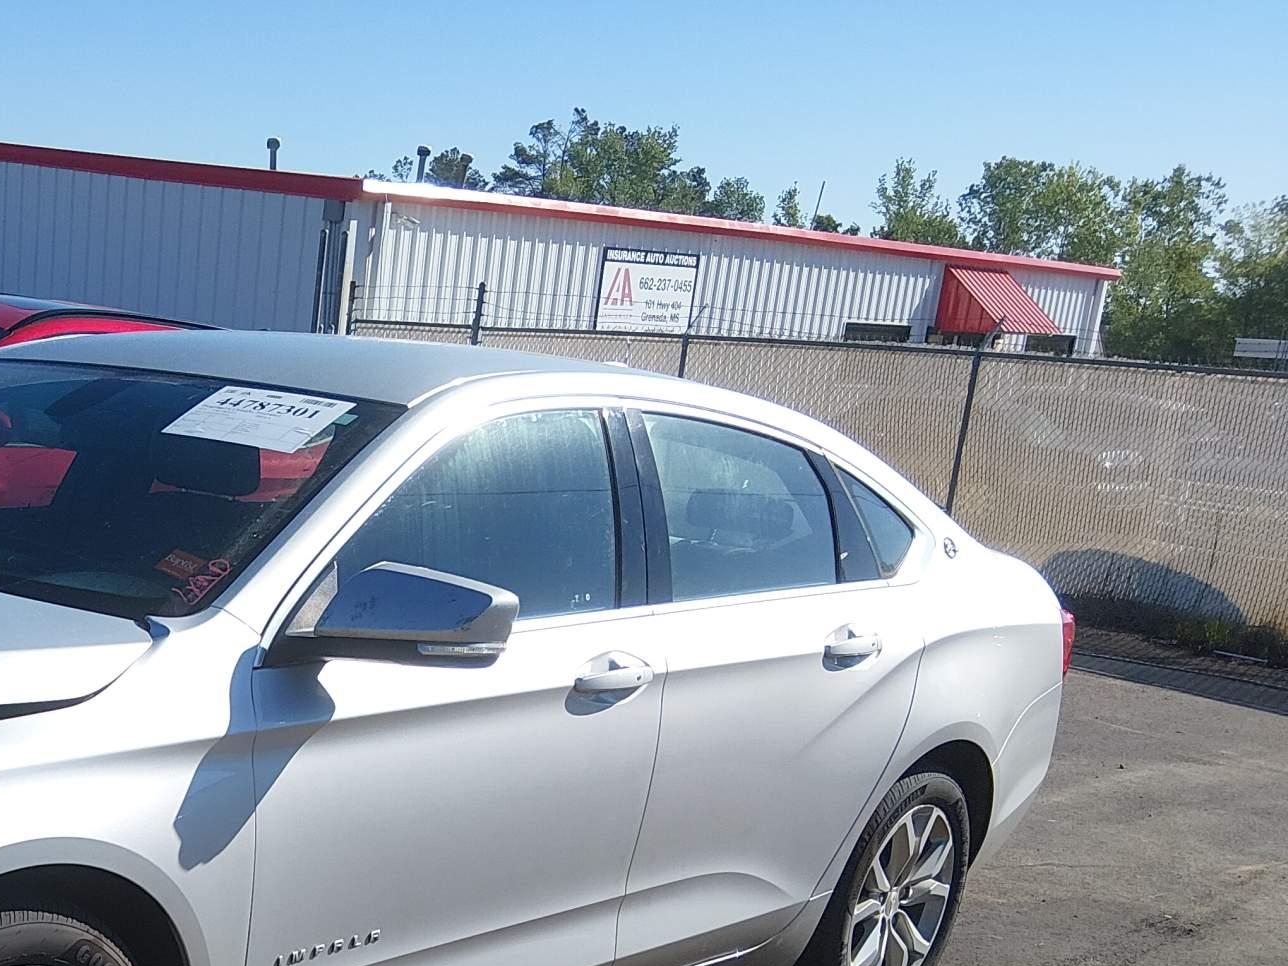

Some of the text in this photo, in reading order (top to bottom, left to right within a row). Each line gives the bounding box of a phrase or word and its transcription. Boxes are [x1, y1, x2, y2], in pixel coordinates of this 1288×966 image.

[606, 249, 697, 266] INSURANCE AUTO AUCTIONS
[639, 277, 693, 293] 662-237-0455
[656, 301, 670, 312] Hwy
[216, 396, 321, 419] 44787301
